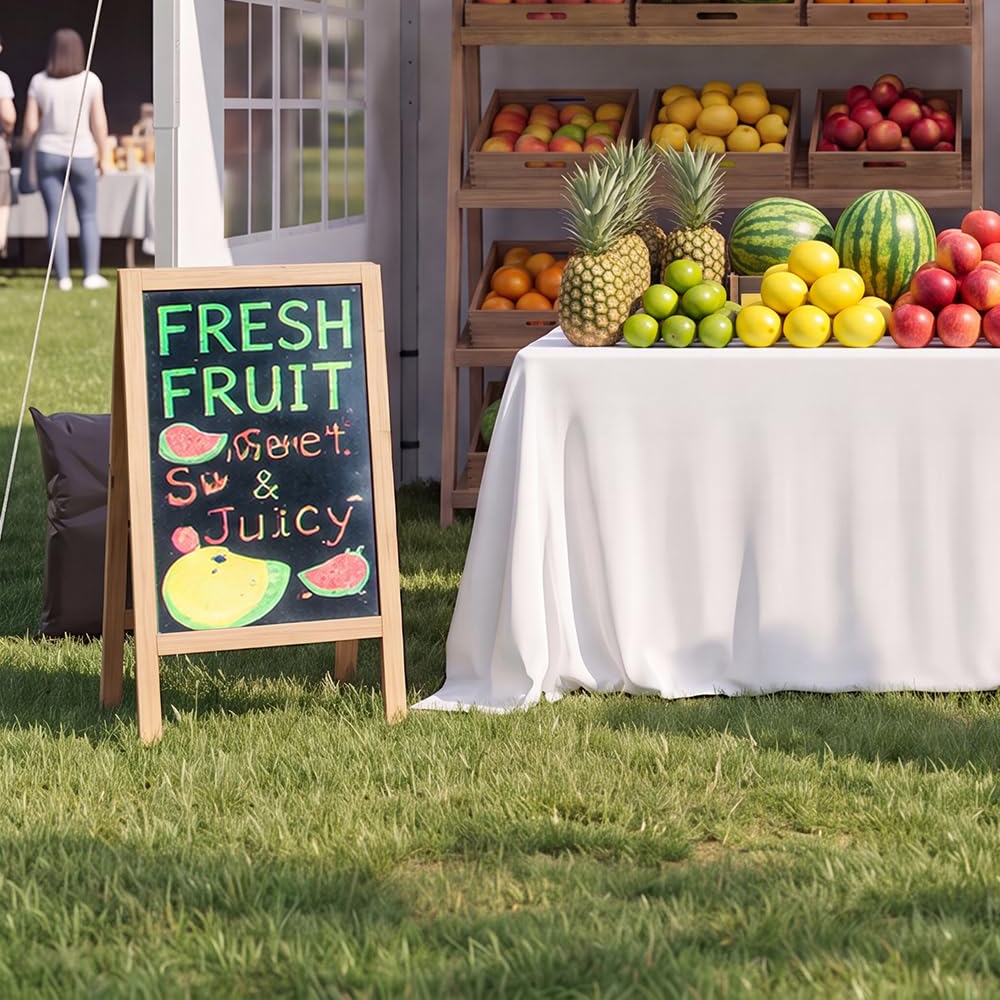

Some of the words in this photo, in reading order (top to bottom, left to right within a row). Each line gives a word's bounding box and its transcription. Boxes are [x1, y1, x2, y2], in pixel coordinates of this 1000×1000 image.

[157, 300, 352, 356] FRESH
[162, 361, 352, 419] FRUIT
[253, 469, 279, 500] &
[203, 504, 354, 547] Juicy
